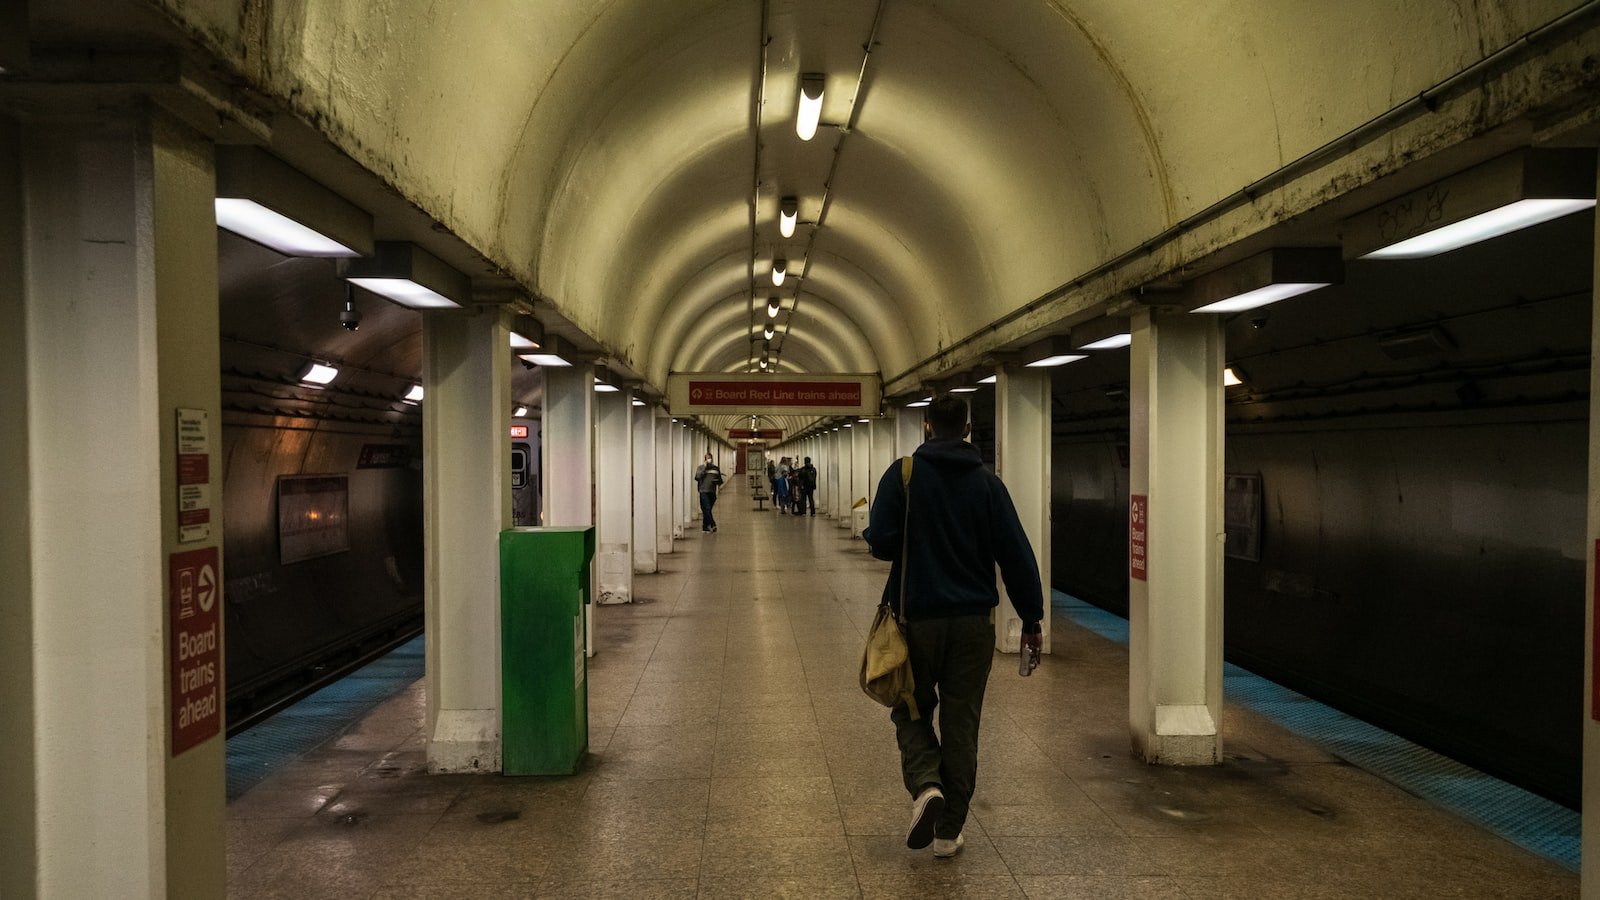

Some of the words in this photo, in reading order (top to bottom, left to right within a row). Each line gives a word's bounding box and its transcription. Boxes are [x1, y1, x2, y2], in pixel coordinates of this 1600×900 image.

[715, 389, 747, 400] Board
[750, 389, 770, 400] Red
[773, 389, 795, 400] Line
[797, 390, 826, 400] trains
[828, 390, 860, 400] ahead
[1132, 527, 1145, 542] Board
[1132, 542, 1145, 556] trains
[1132, 556, 1145, 571] ahead
[179, 622, 216, 661] Board
[180, 660, 215, 695] trains
[178, 686, 216, 729] ahead
